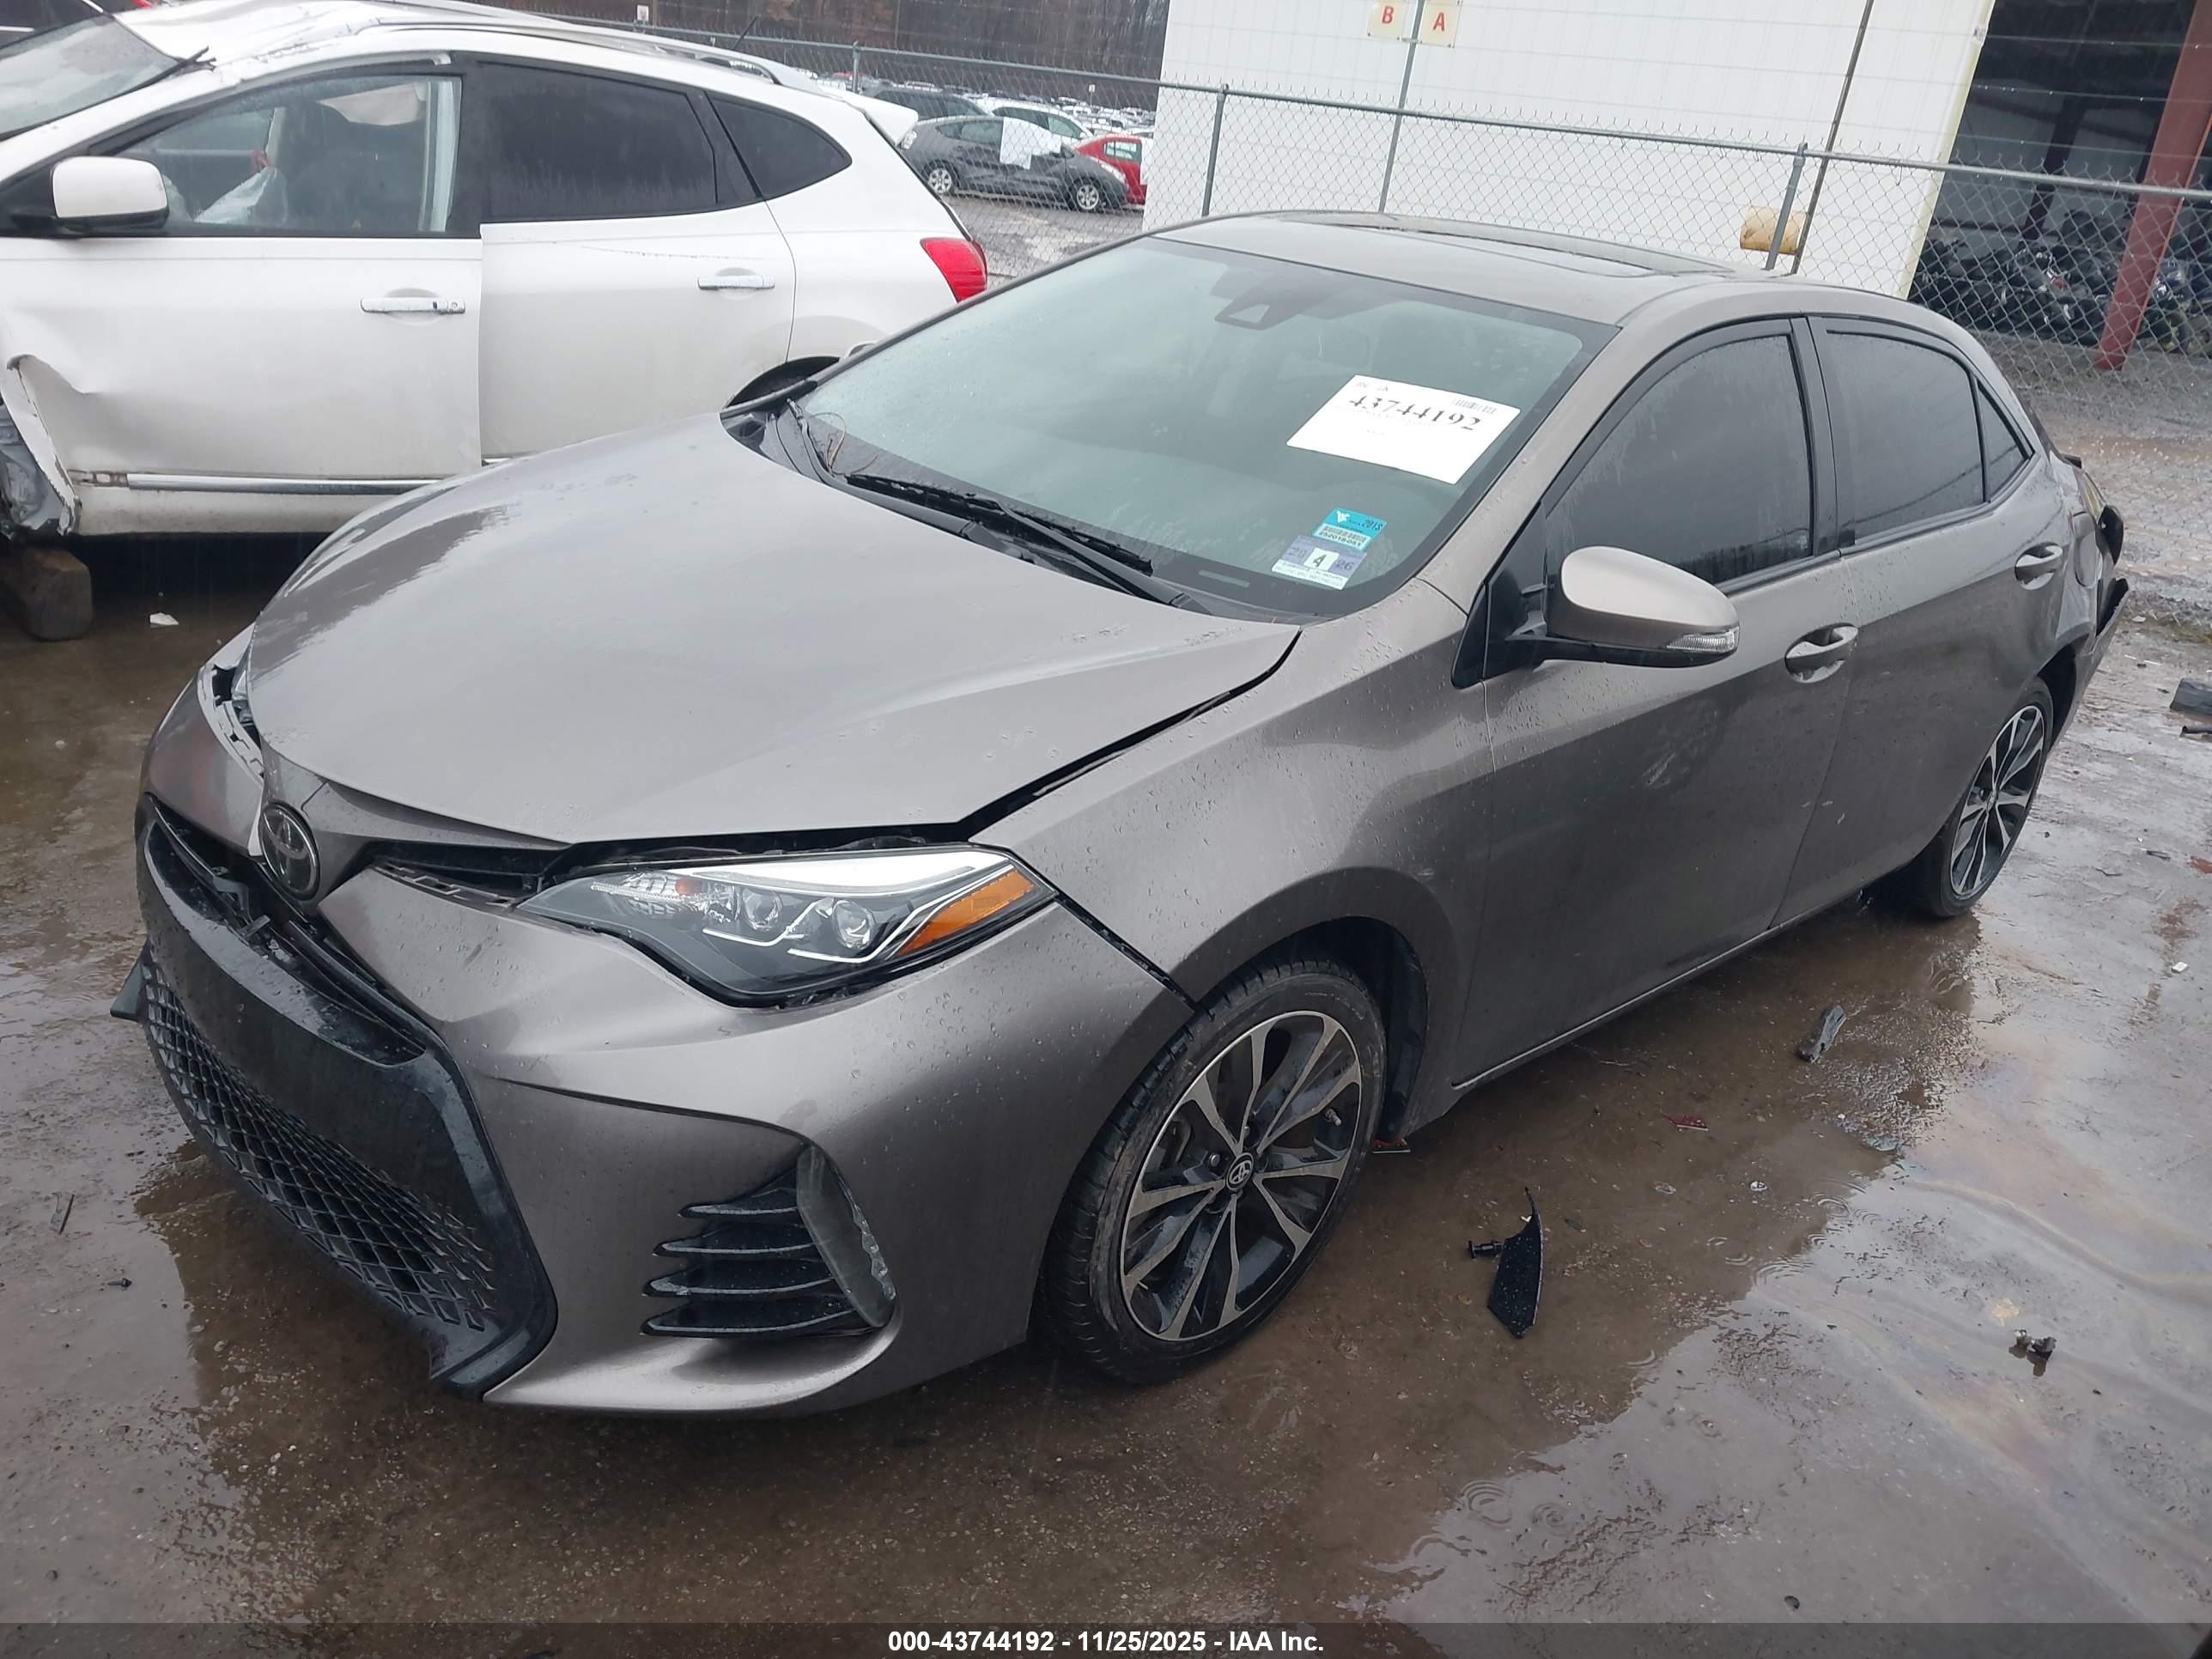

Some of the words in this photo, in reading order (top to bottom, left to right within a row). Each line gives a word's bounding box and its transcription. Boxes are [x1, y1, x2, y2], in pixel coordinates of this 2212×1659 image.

[1381, 5, 1395, 25] B
[1432, 12, 1446, 32] A
[1349, 395, 1481, 431] 43744192
[1312, 554, 1327, 568] 4
